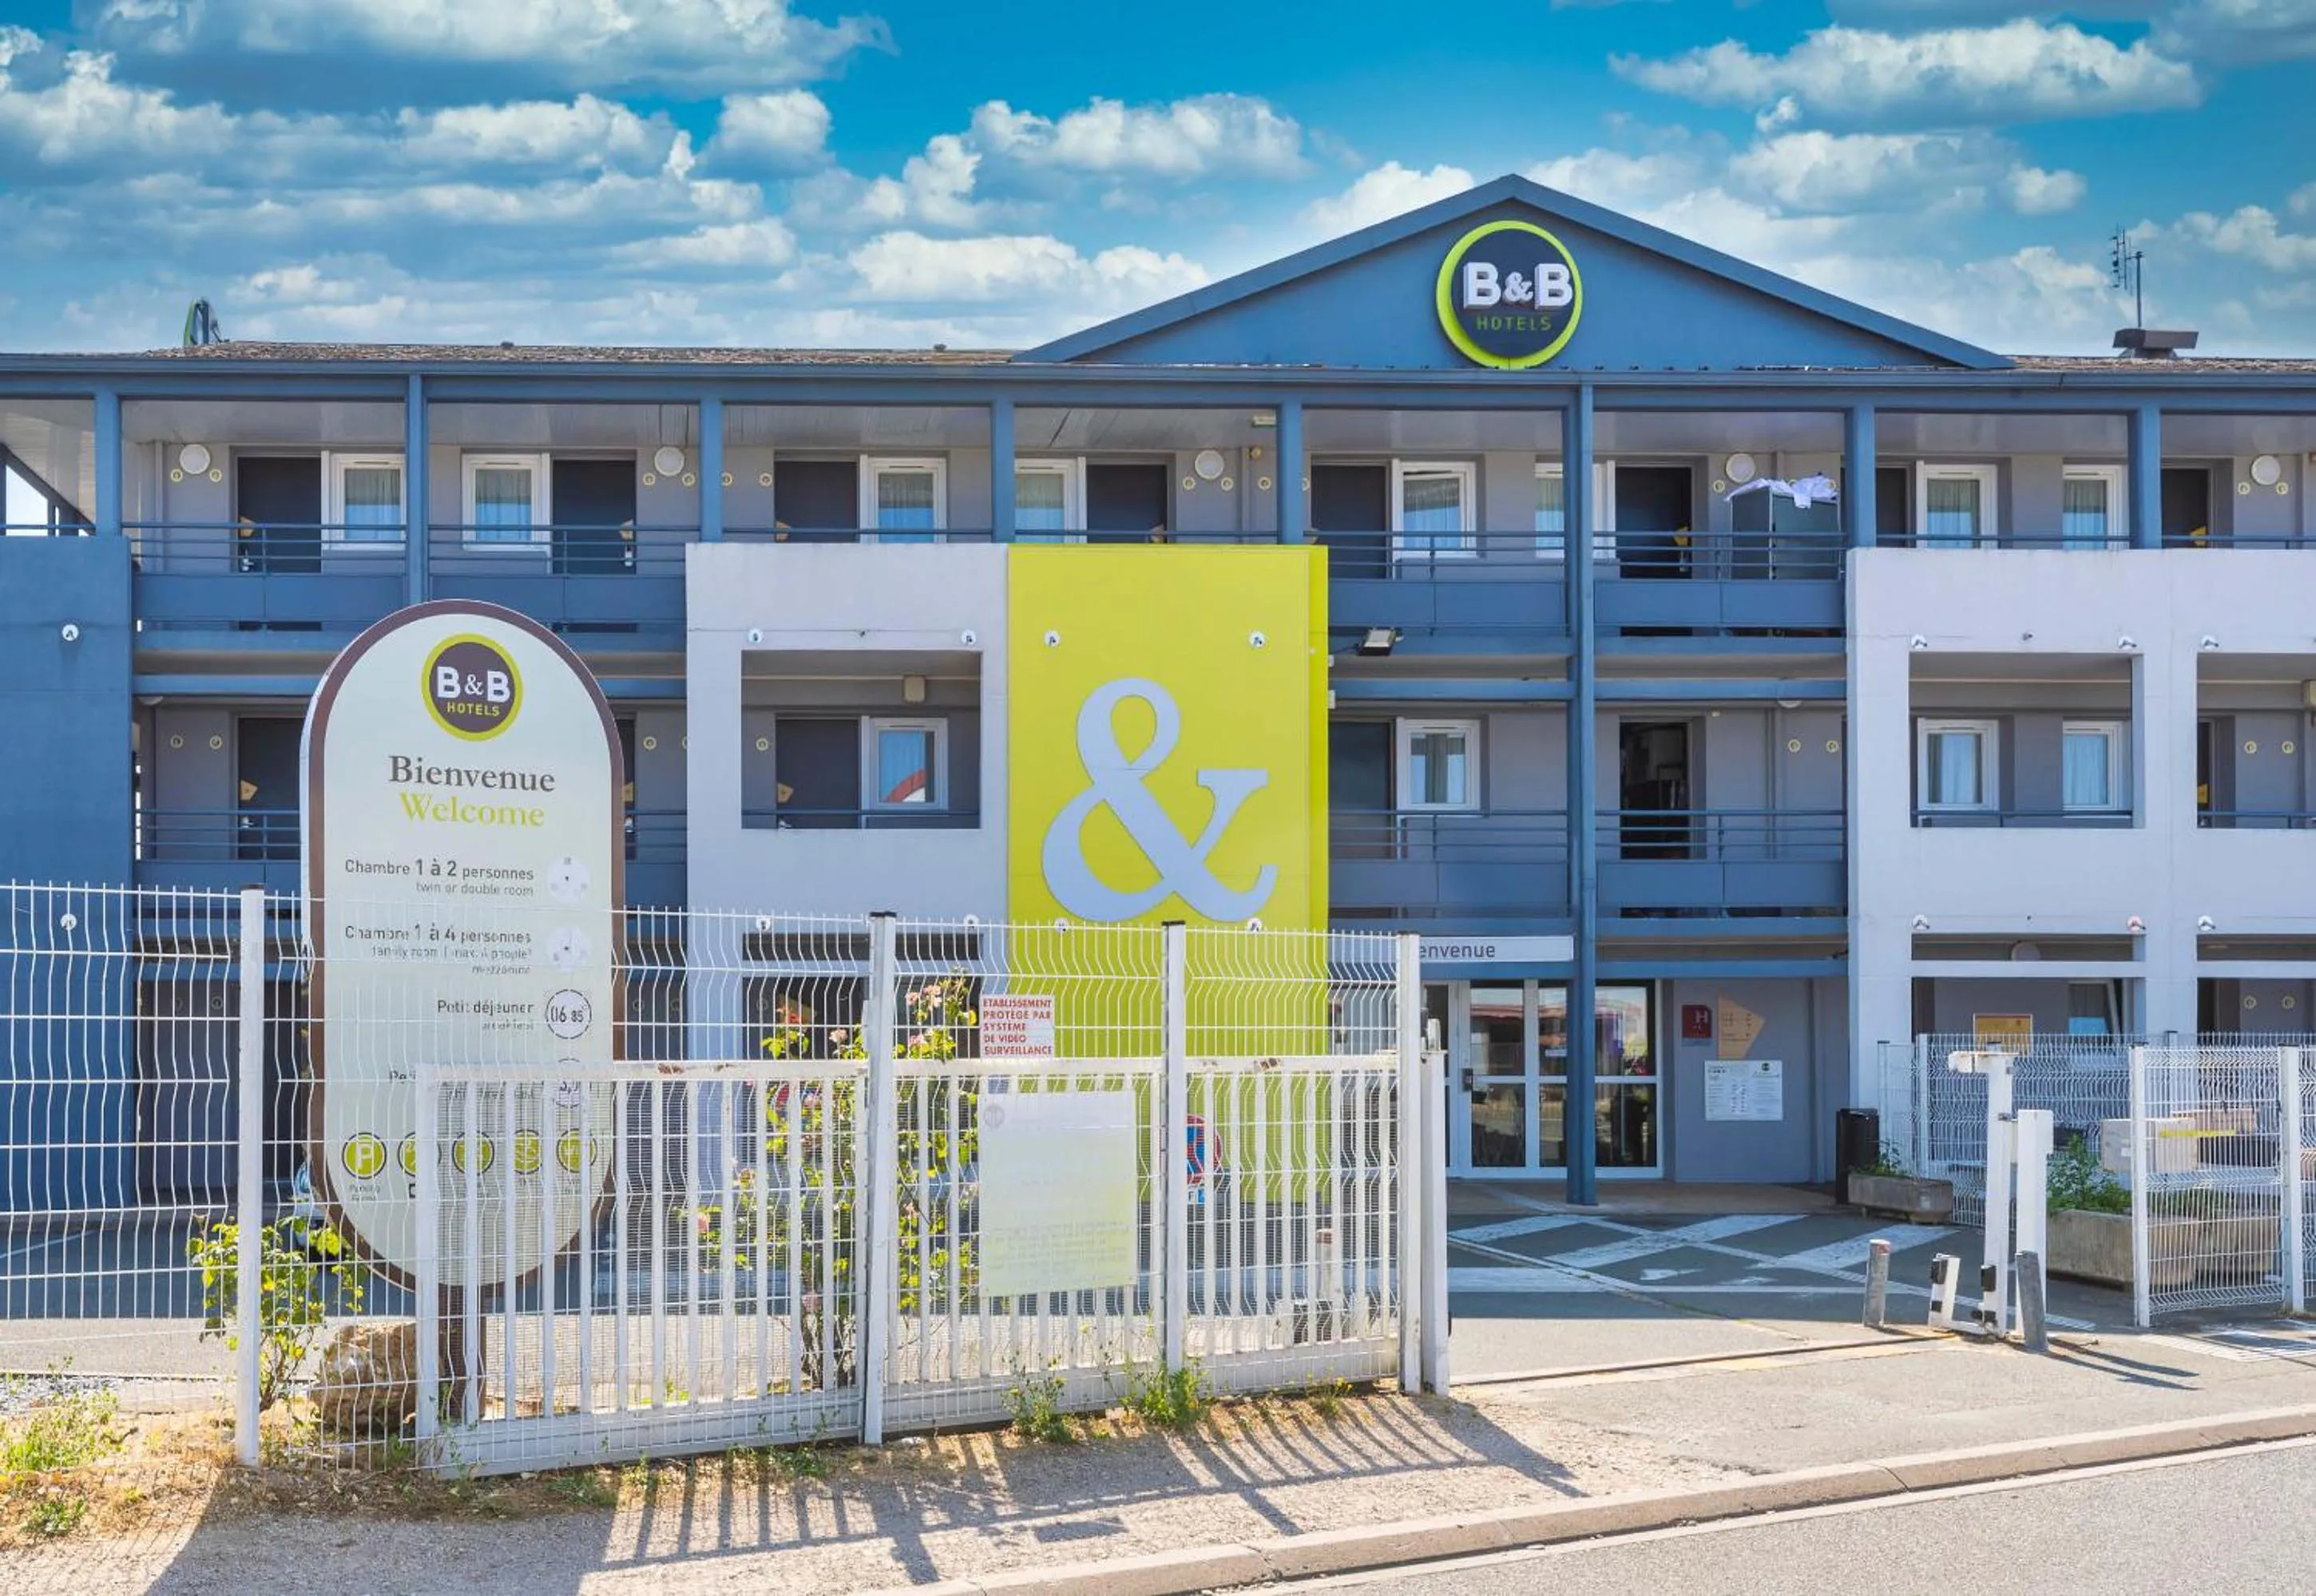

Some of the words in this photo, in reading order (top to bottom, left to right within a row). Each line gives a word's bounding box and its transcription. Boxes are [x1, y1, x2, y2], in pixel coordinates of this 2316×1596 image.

[1463, 262, 1572, 310] B&B
[1477, 315, 1552, 331] HOTELS
[436, 666, 510, 703] B&B
[446, 702, 500, 717] HOTELS
[388, 755, 556, 792] Bienvenue
[1041, 675, 1278, 923] &
[399, 791, 545, 826] Welcome
[345, 859, 410, 874] Chambre
[415, 858, 422, 875] 1
[431, 857, 441, 876] à
[446, 860, 457, 877] 2
[462, 867, 534, 880] personnes
[416, 881, 441, 893] twin
[1419, 945, 1496, 958] envenue
[1033, 1011, 1051, 1020] PAR
[984, 1034, 993, 1043] DE
[984, 1046, 1053, 1055] SURVEILLANCE
